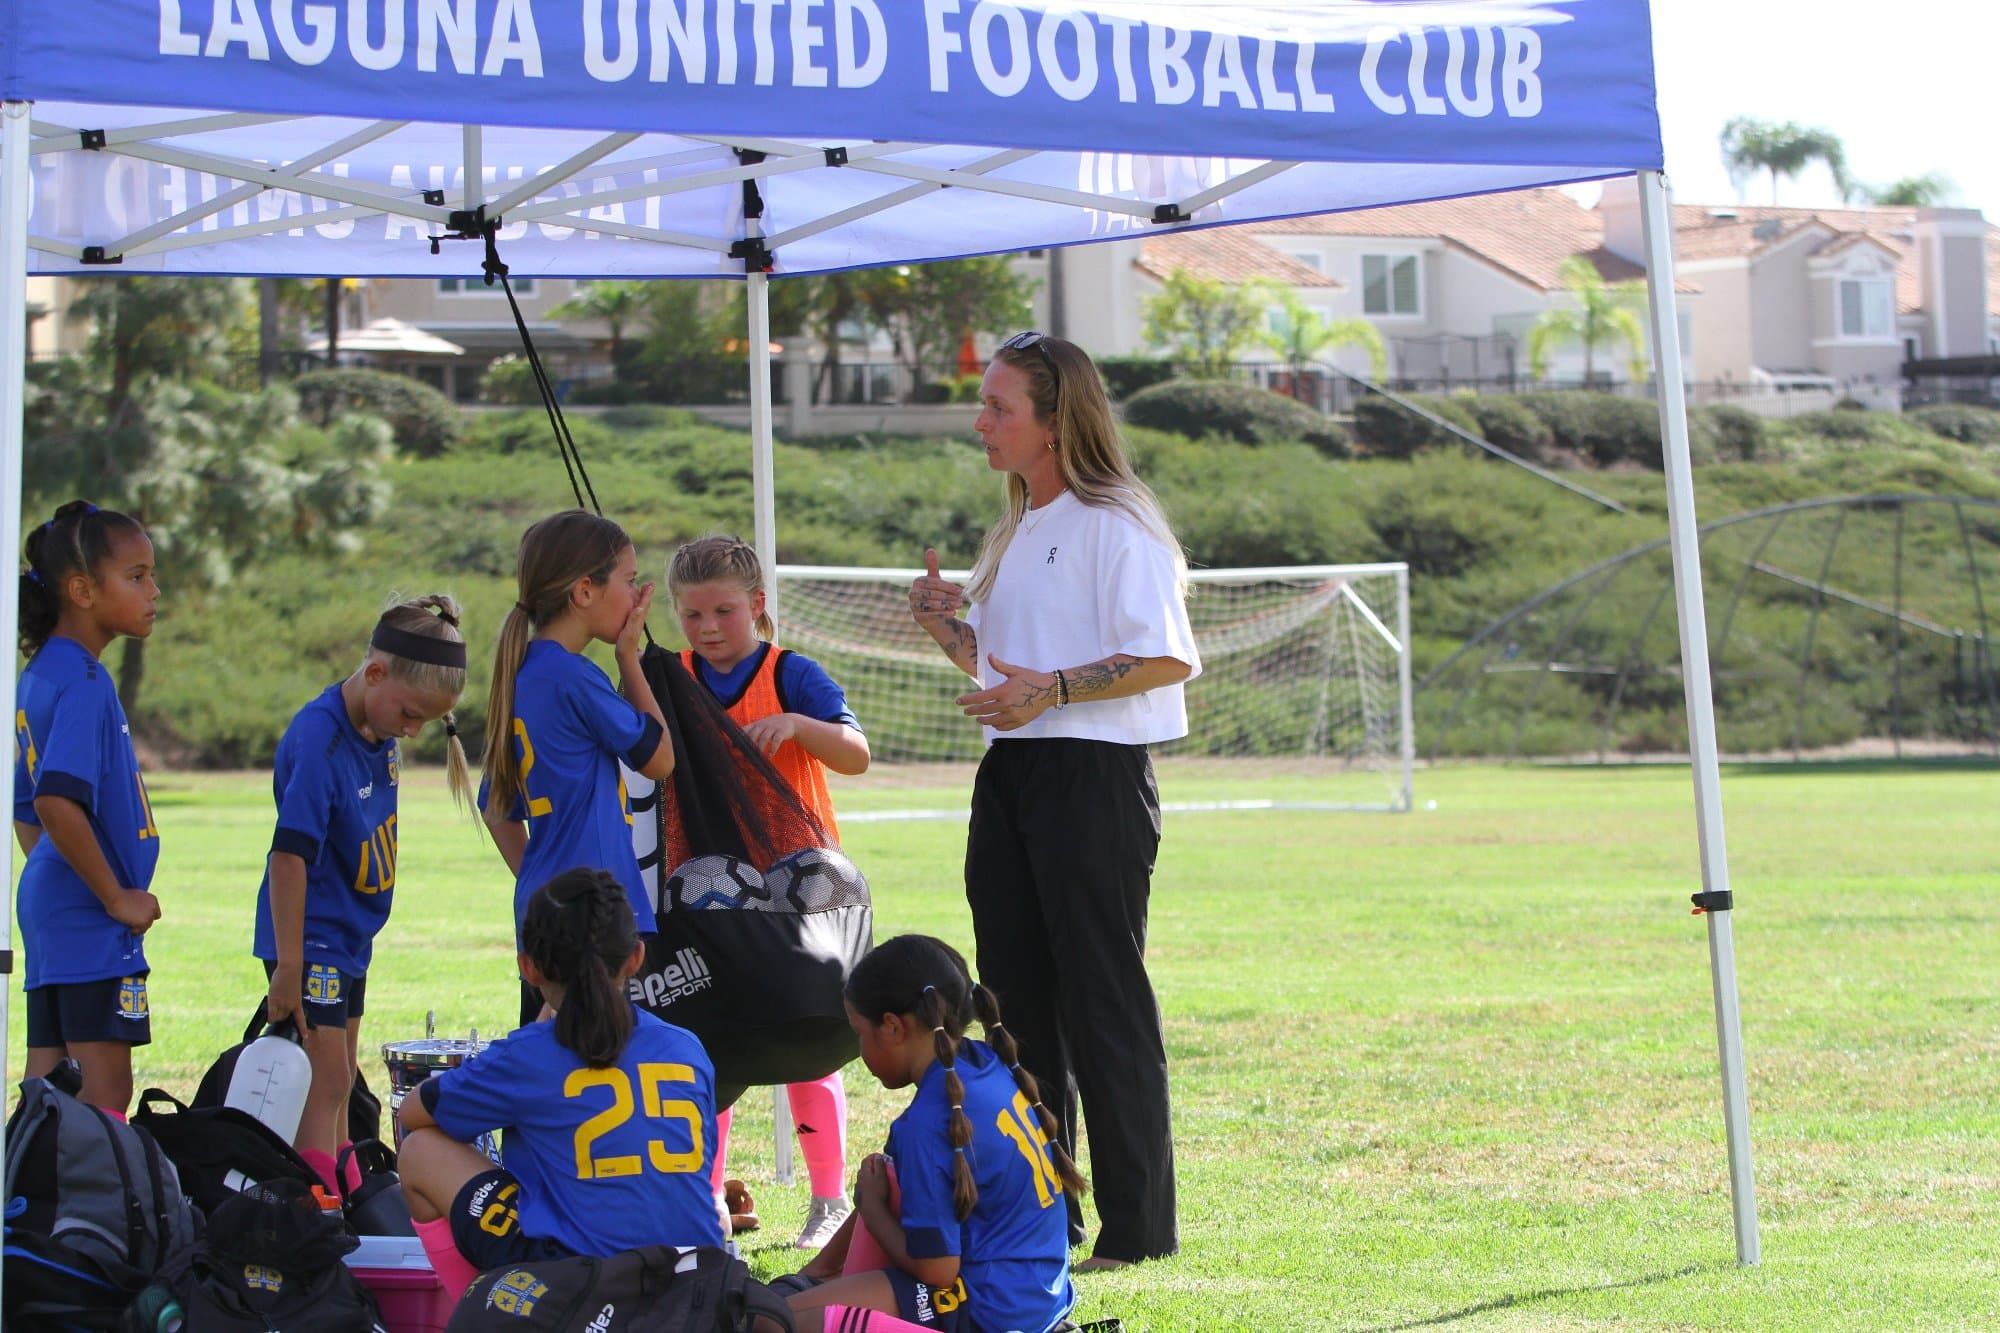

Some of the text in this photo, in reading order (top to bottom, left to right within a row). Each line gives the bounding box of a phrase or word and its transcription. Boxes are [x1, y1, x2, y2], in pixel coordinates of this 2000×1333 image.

[159, 0, 1543, 118] LAGUNA UNITED FOOTBALL CLUB
[629, 946, 709, 1008] apelli
[659, 976, 713, 1008] SPORT
[563, 1062, 704, 1180] 25
